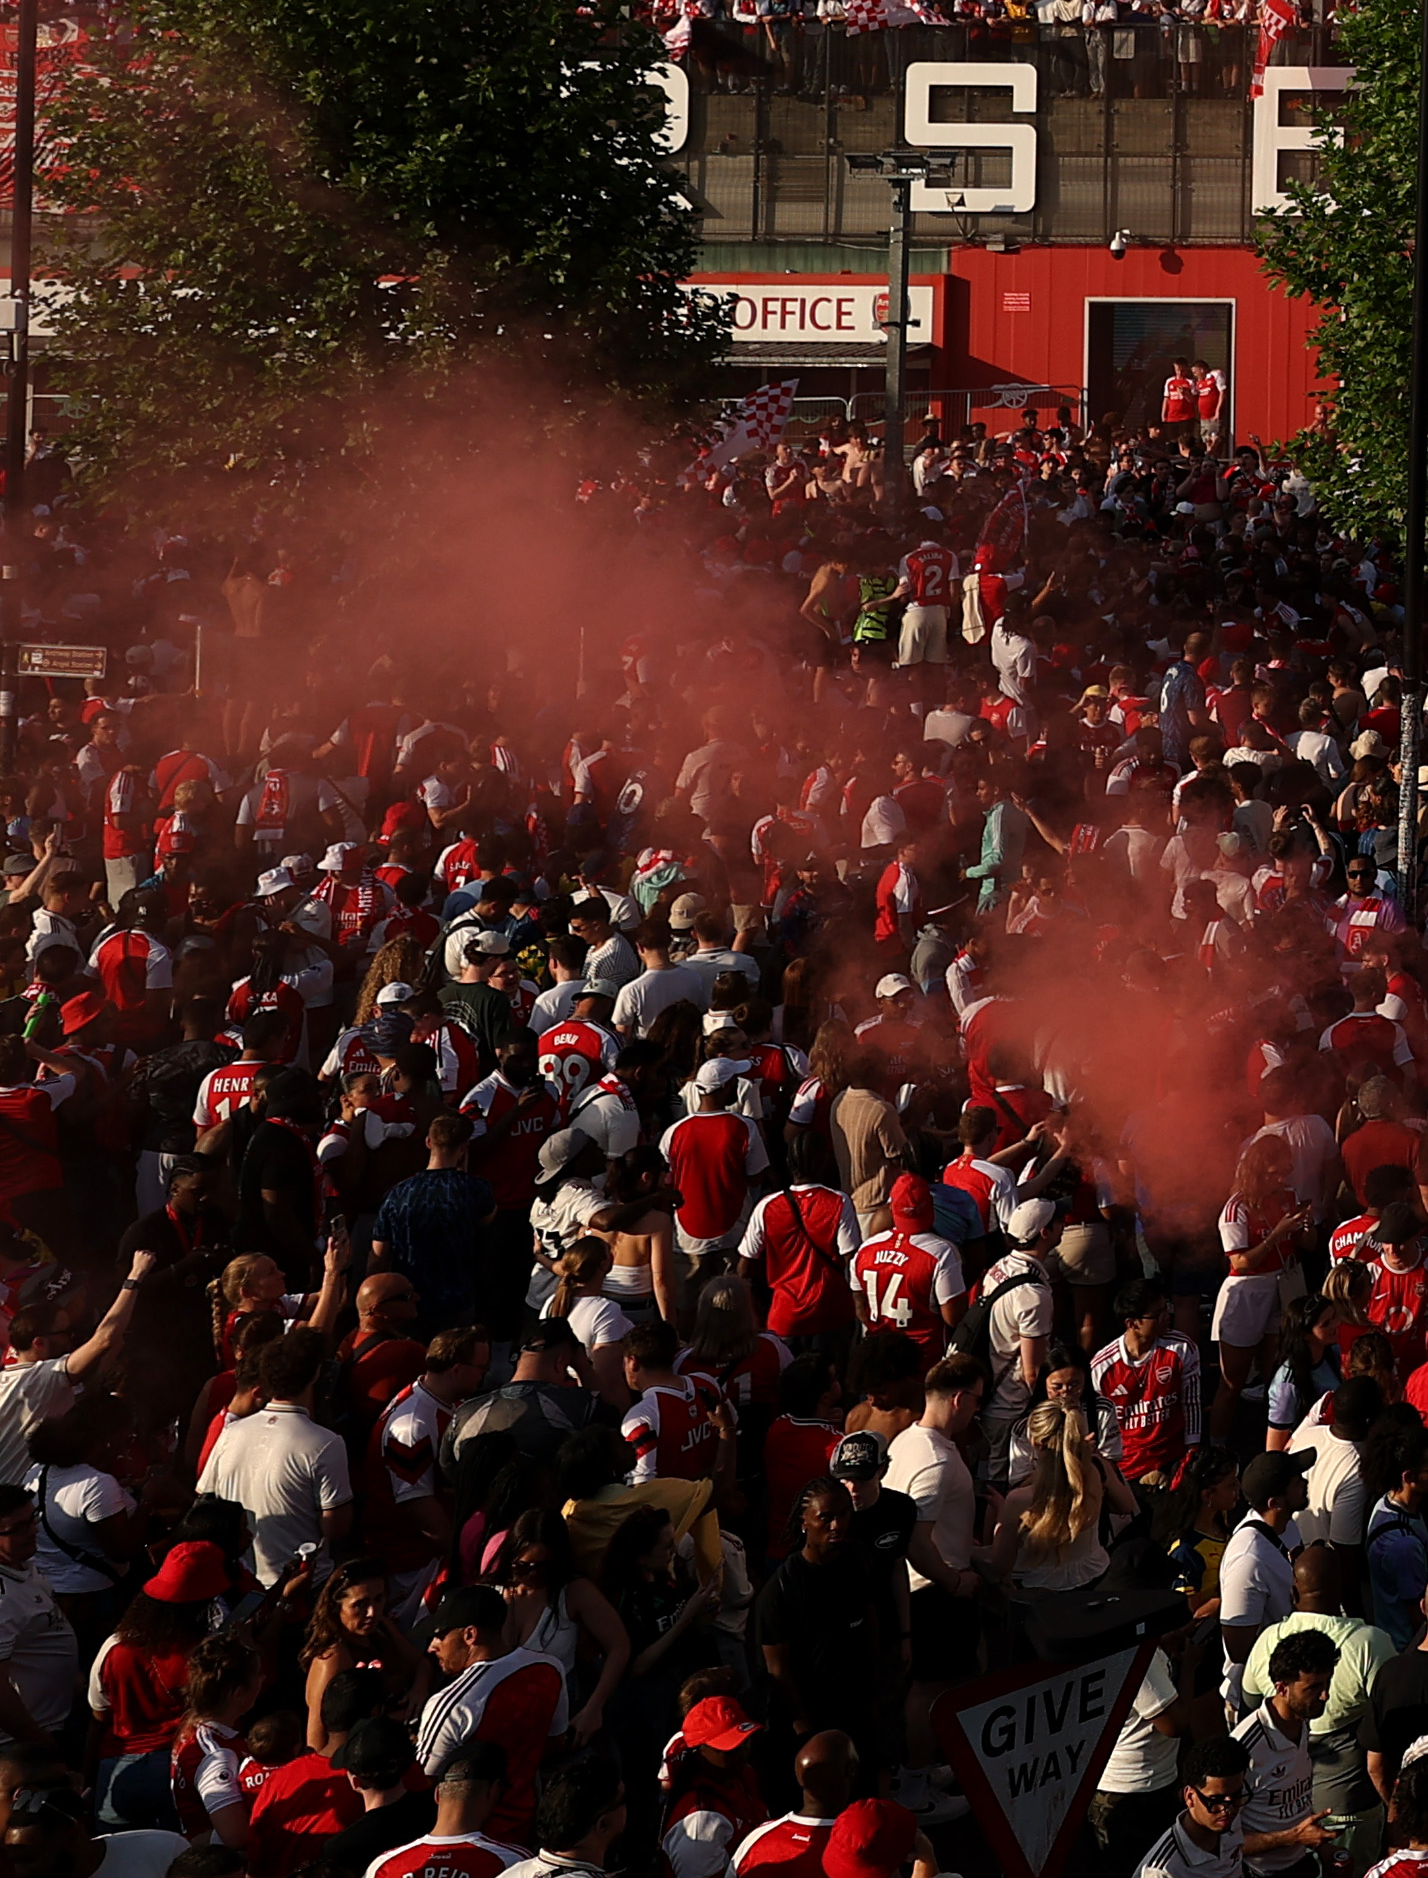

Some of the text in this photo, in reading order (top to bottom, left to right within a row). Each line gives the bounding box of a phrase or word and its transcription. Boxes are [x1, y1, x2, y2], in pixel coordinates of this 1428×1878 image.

[732, 296, 856, 331] OFFICE
[924, 565, 943, 597] 2
[213, 1076, 254, 1093] HENR
[511, 1116, 544, 1137] JVC
[874, 1250, 910, 1267] JUZZY
[862, 1269, 914, 1328] 14
[1115, 1393, 1179, 1421] Emirates
[1125, 1406, 1171, 1431] FLY BETTER
[980, 1669, 1107, 1759] GIVE
[1006, 1739, 1089, 1800] WAY
